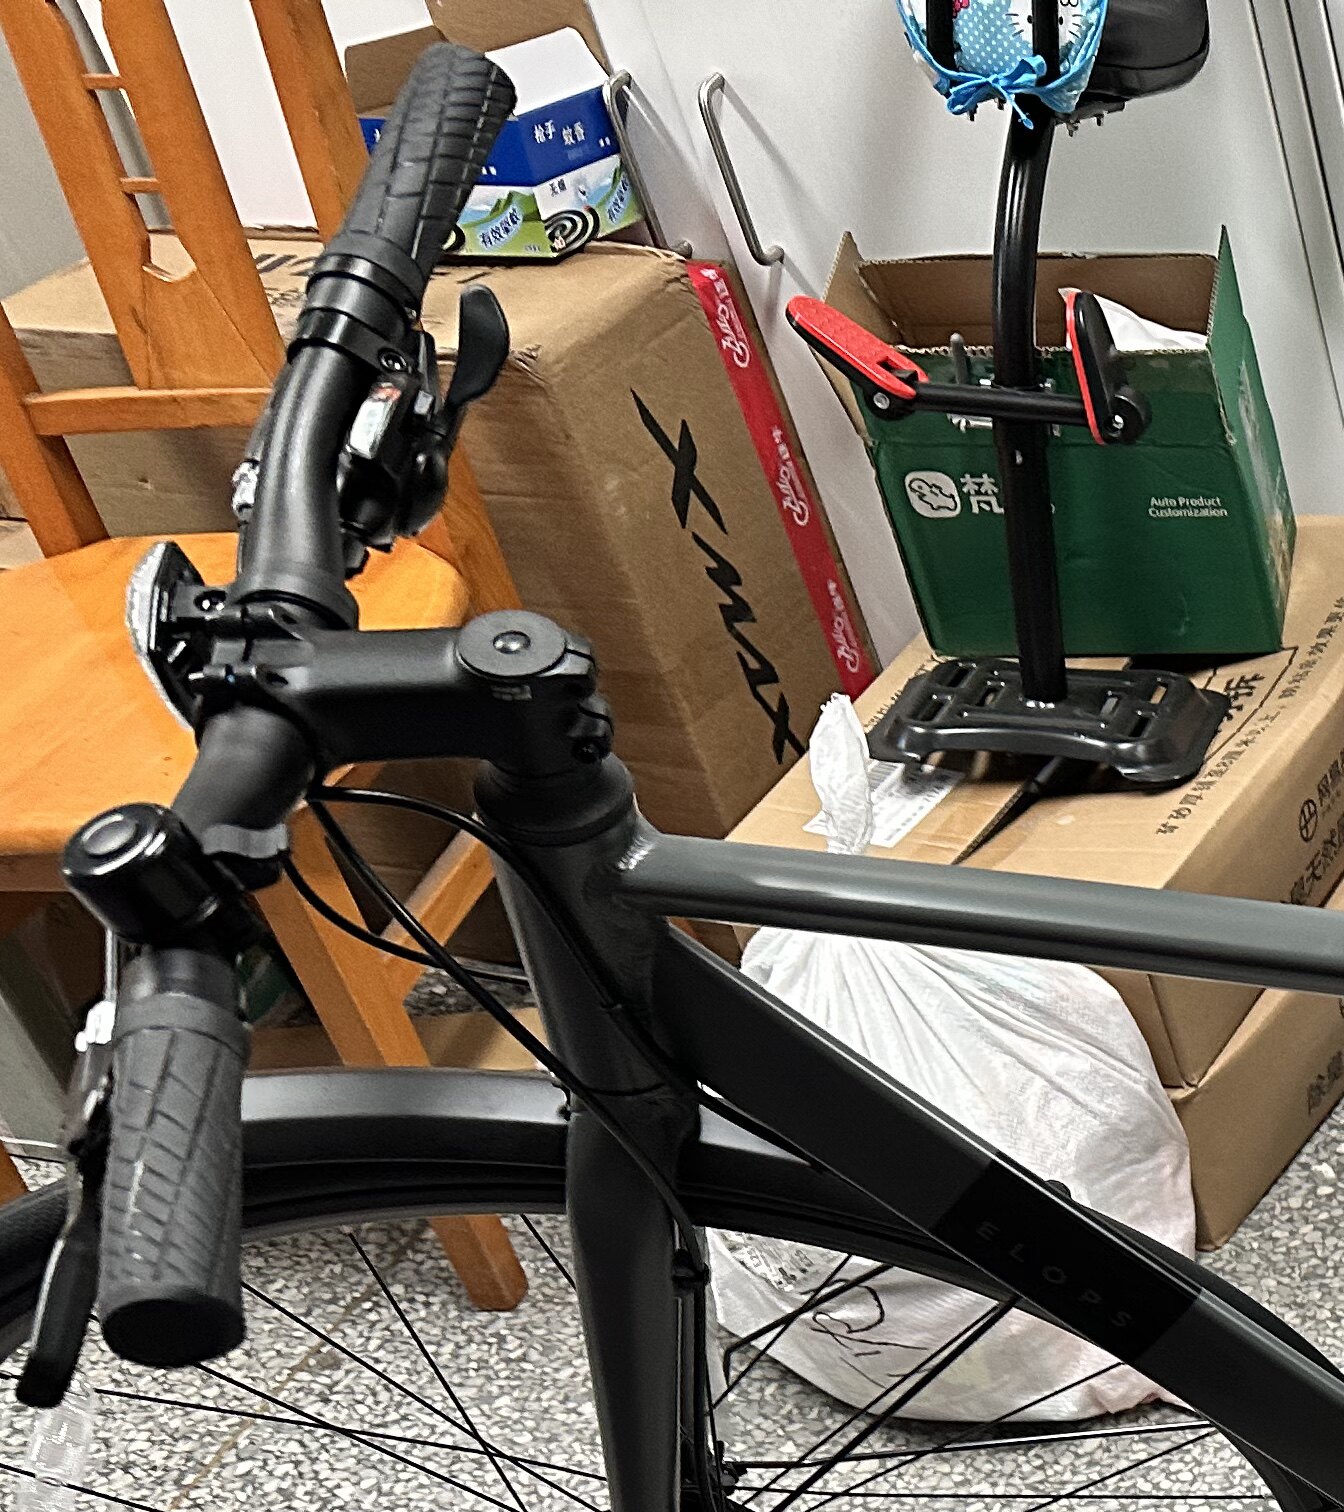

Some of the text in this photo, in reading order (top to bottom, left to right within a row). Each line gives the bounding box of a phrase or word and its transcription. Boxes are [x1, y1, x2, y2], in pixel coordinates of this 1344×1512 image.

[1150, 496, 1222, 507] Auto Product
[1147, 506, 1228, 518] Customization
[977, 1220, 1132, 1328] ELOPS
